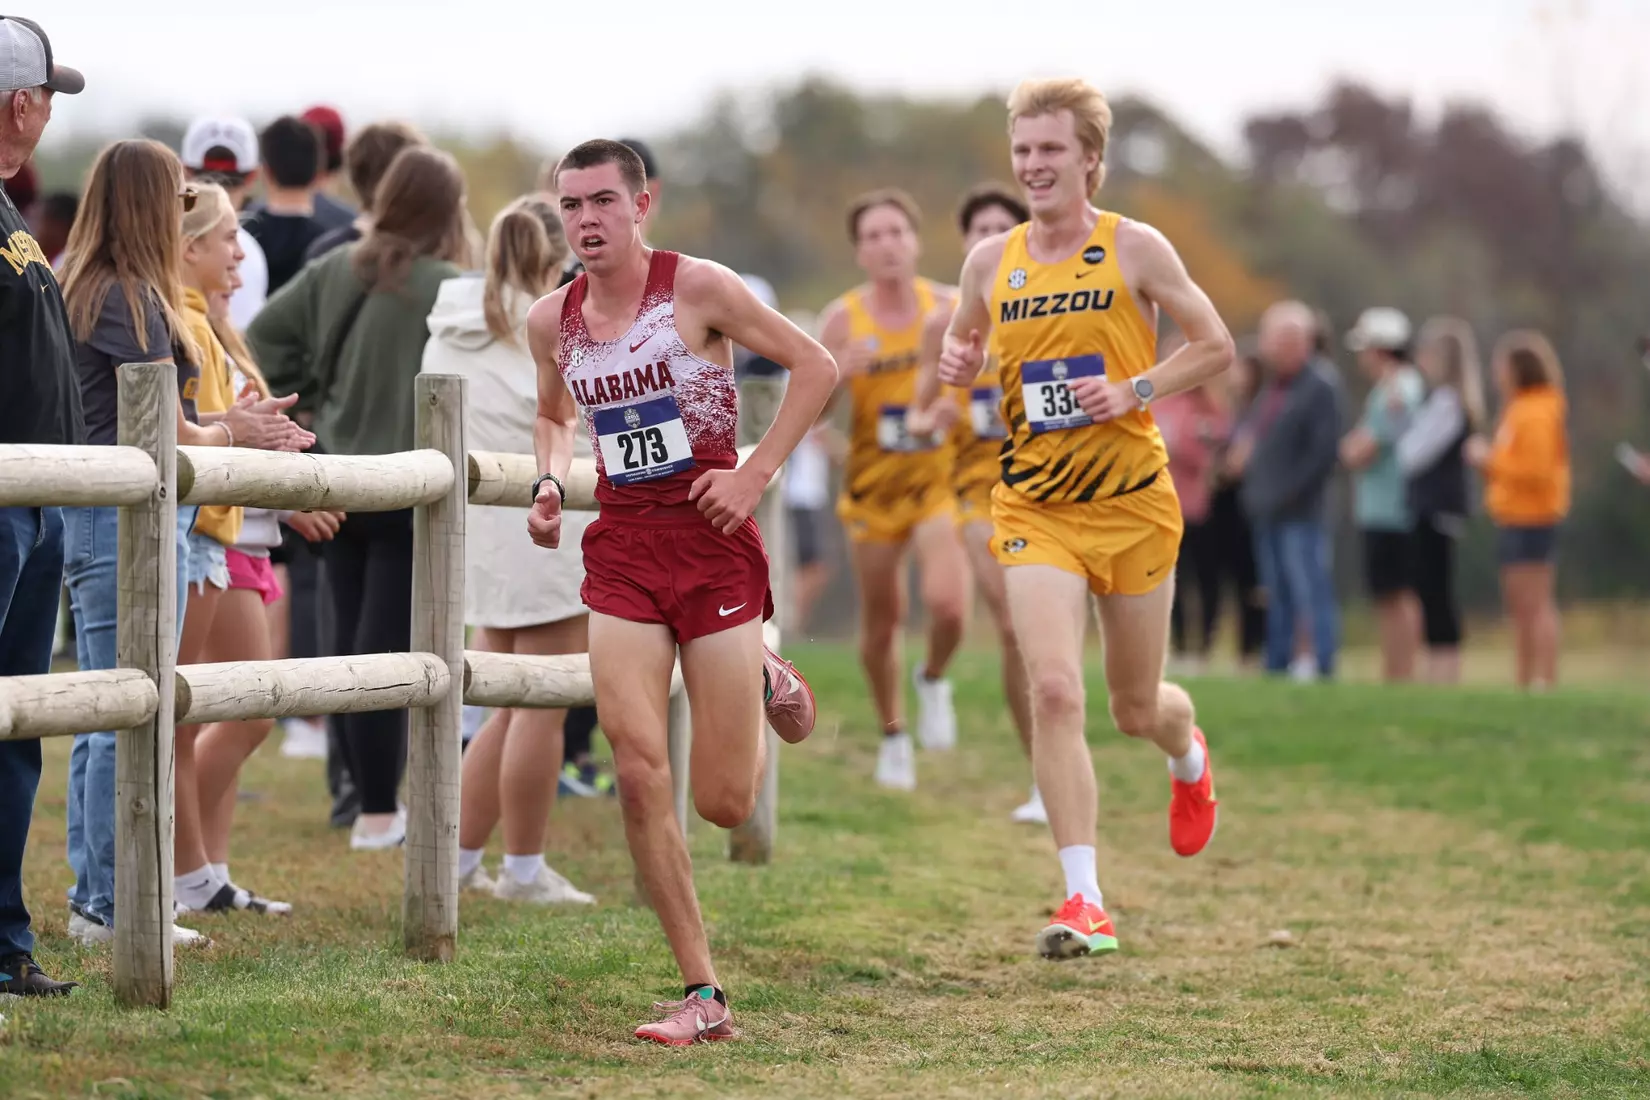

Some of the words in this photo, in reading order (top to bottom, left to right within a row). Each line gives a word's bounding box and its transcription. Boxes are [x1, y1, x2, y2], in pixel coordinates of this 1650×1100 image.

[1000, 289, 1114, 324] MIZZOU
[571, 360, 676, 407] ALABAMA
[616, 427, 669, 470] 273
